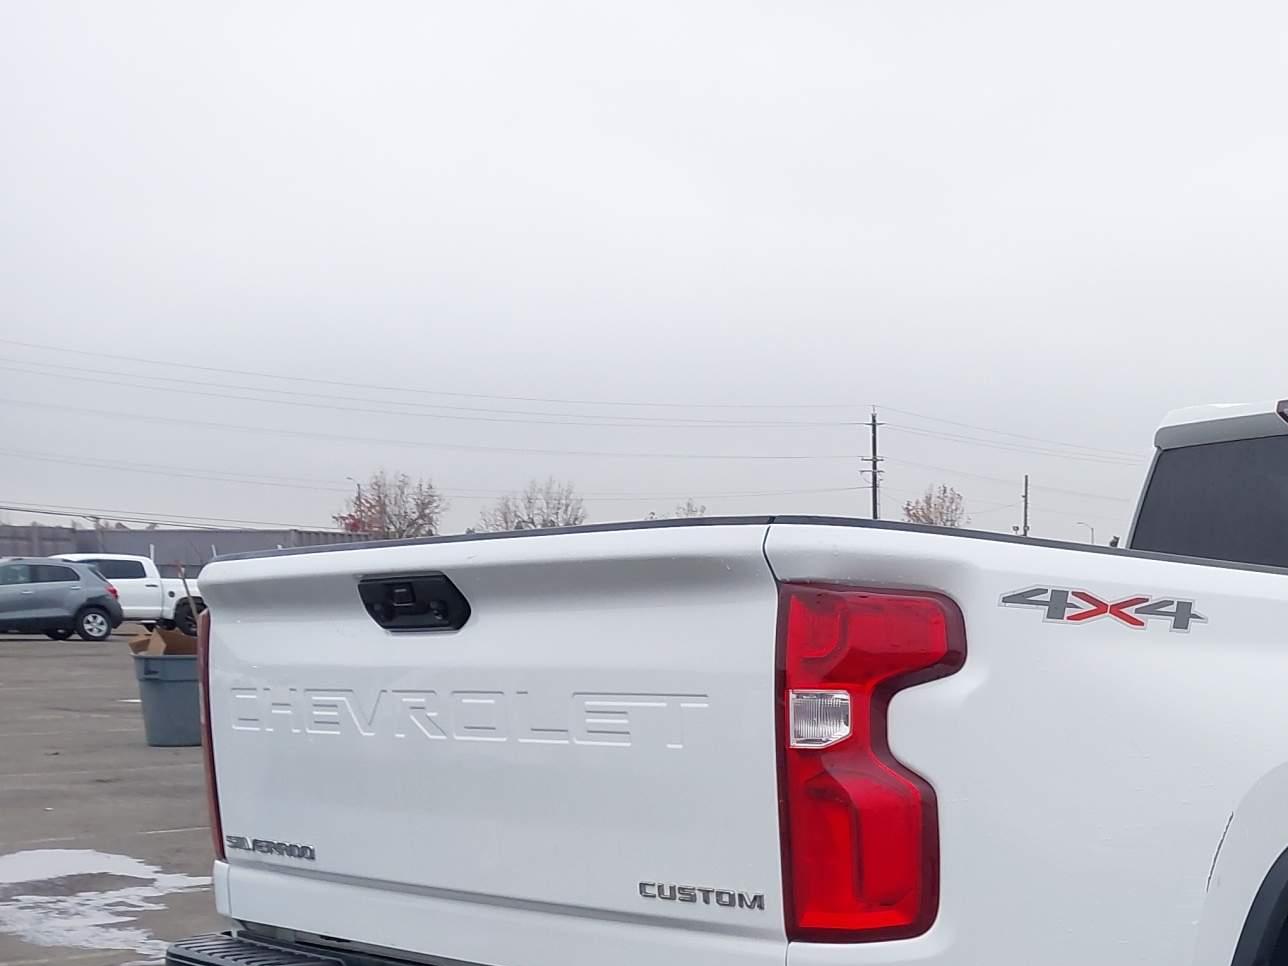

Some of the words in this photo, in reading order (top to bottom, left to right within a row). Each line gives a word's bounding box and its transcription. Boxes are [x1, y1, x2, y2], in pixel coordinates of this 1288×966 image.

[231, 687, 709, 749] CHEVROLET
[226, 835, 315, 860] SILVERADO
[639, 882, 765, 911] CUSTOM
